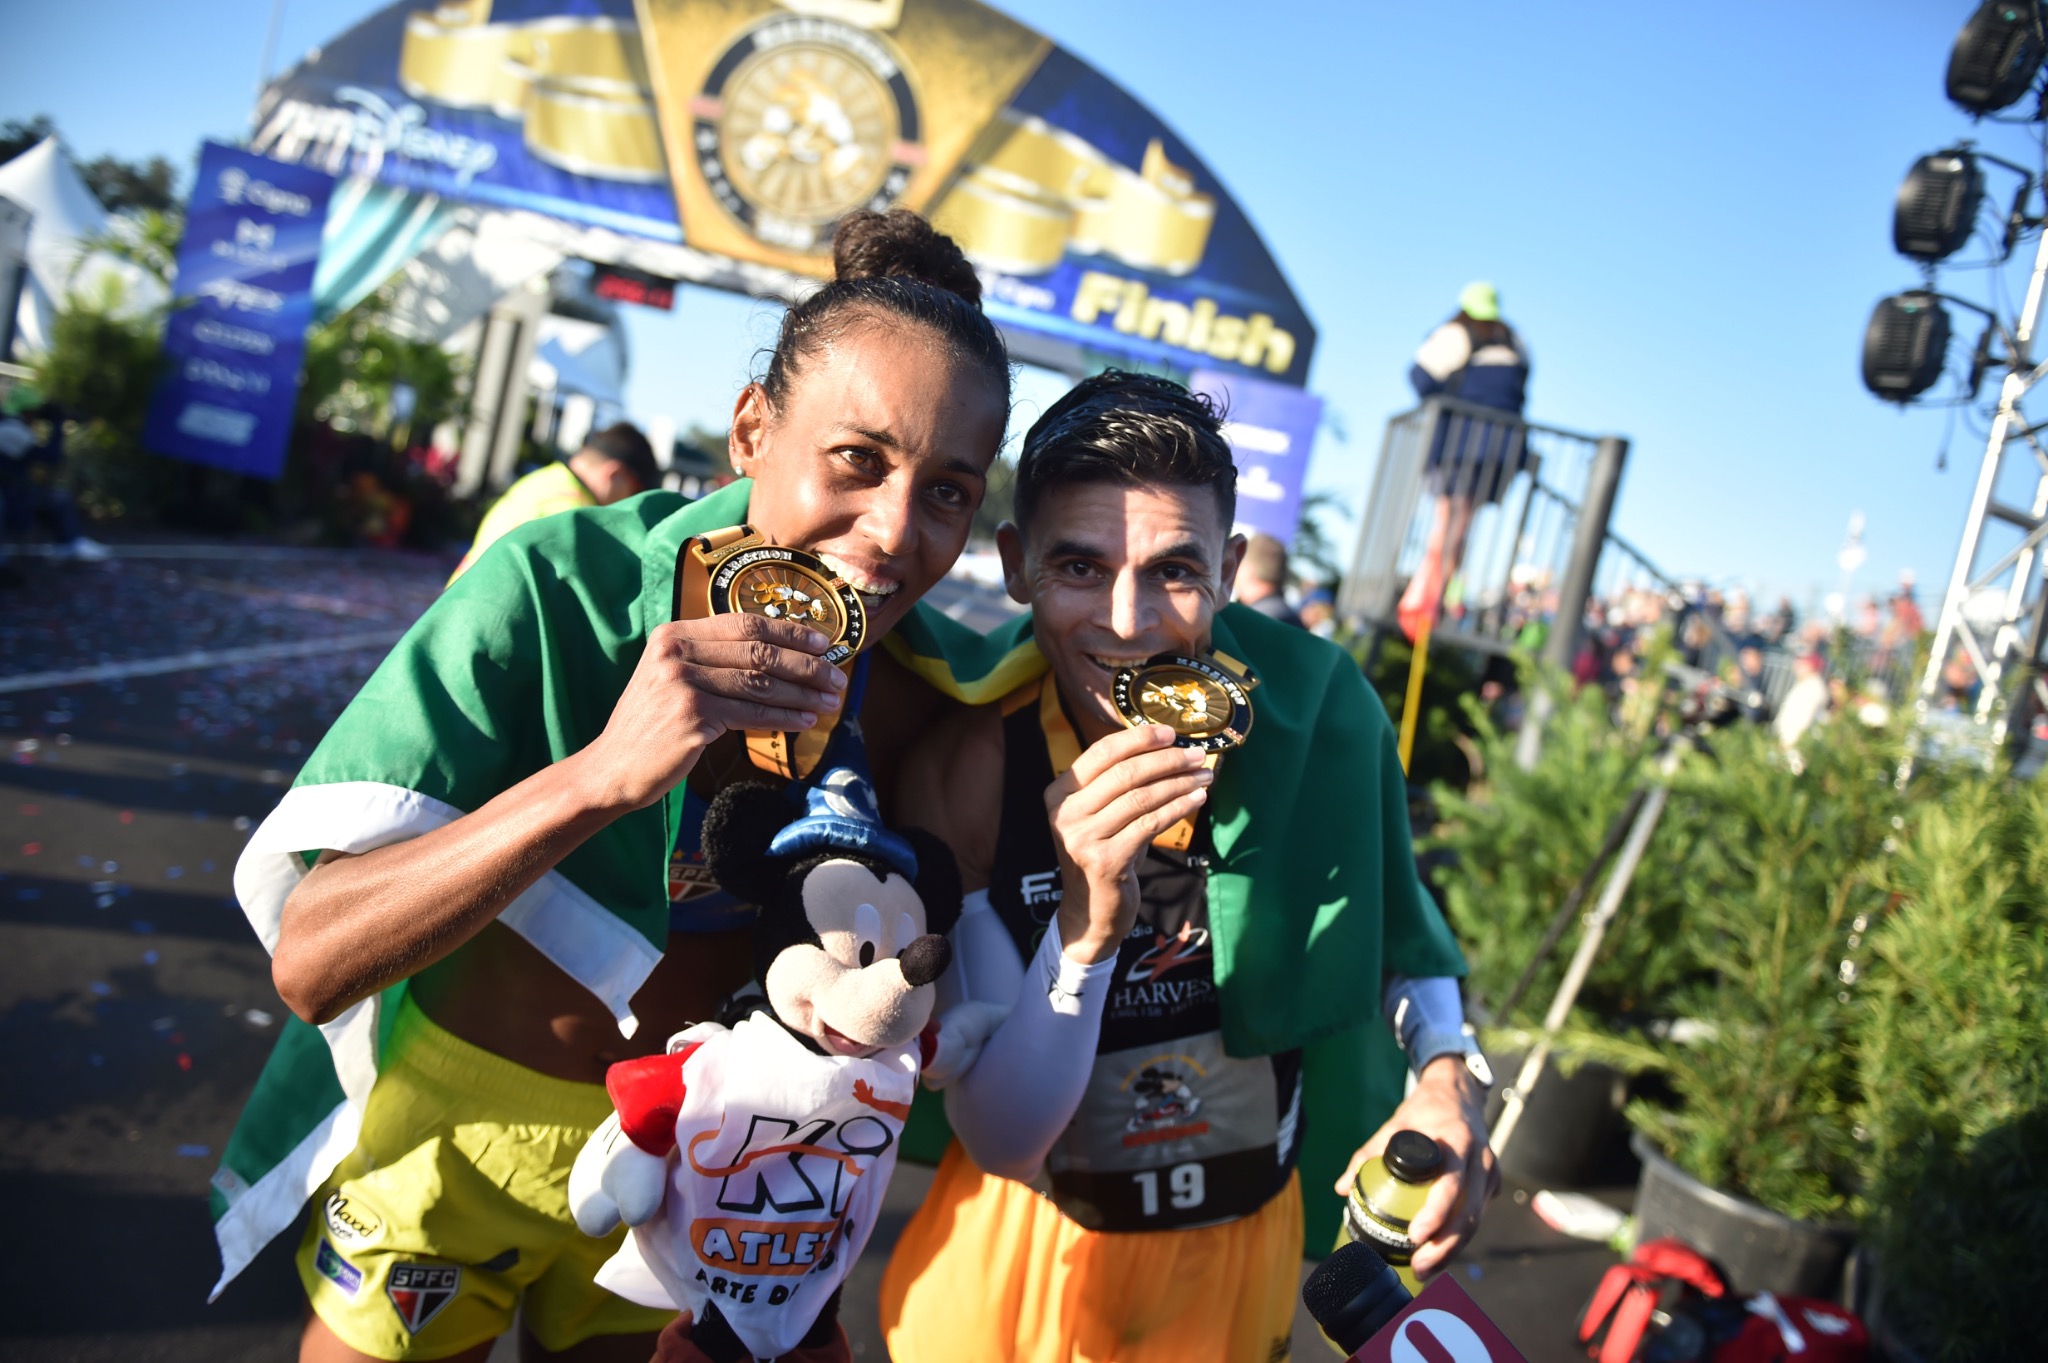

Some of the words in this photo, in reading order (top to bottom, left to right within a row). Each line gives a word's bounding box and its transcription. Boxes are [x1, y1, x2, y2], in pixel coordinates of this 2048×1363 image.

[1071, 270, 1295, 374] Finish
[715, 549, 793, 589] MARATHON
[669, 867, 712, 881] SPF
[1114, 980, 1212, 1009] HARVES
[1132, 1162, 1206, 1216] 19
[393, 1269, 455, 1287] SPFC
[695, 1268, 759, 1304] ARTE
